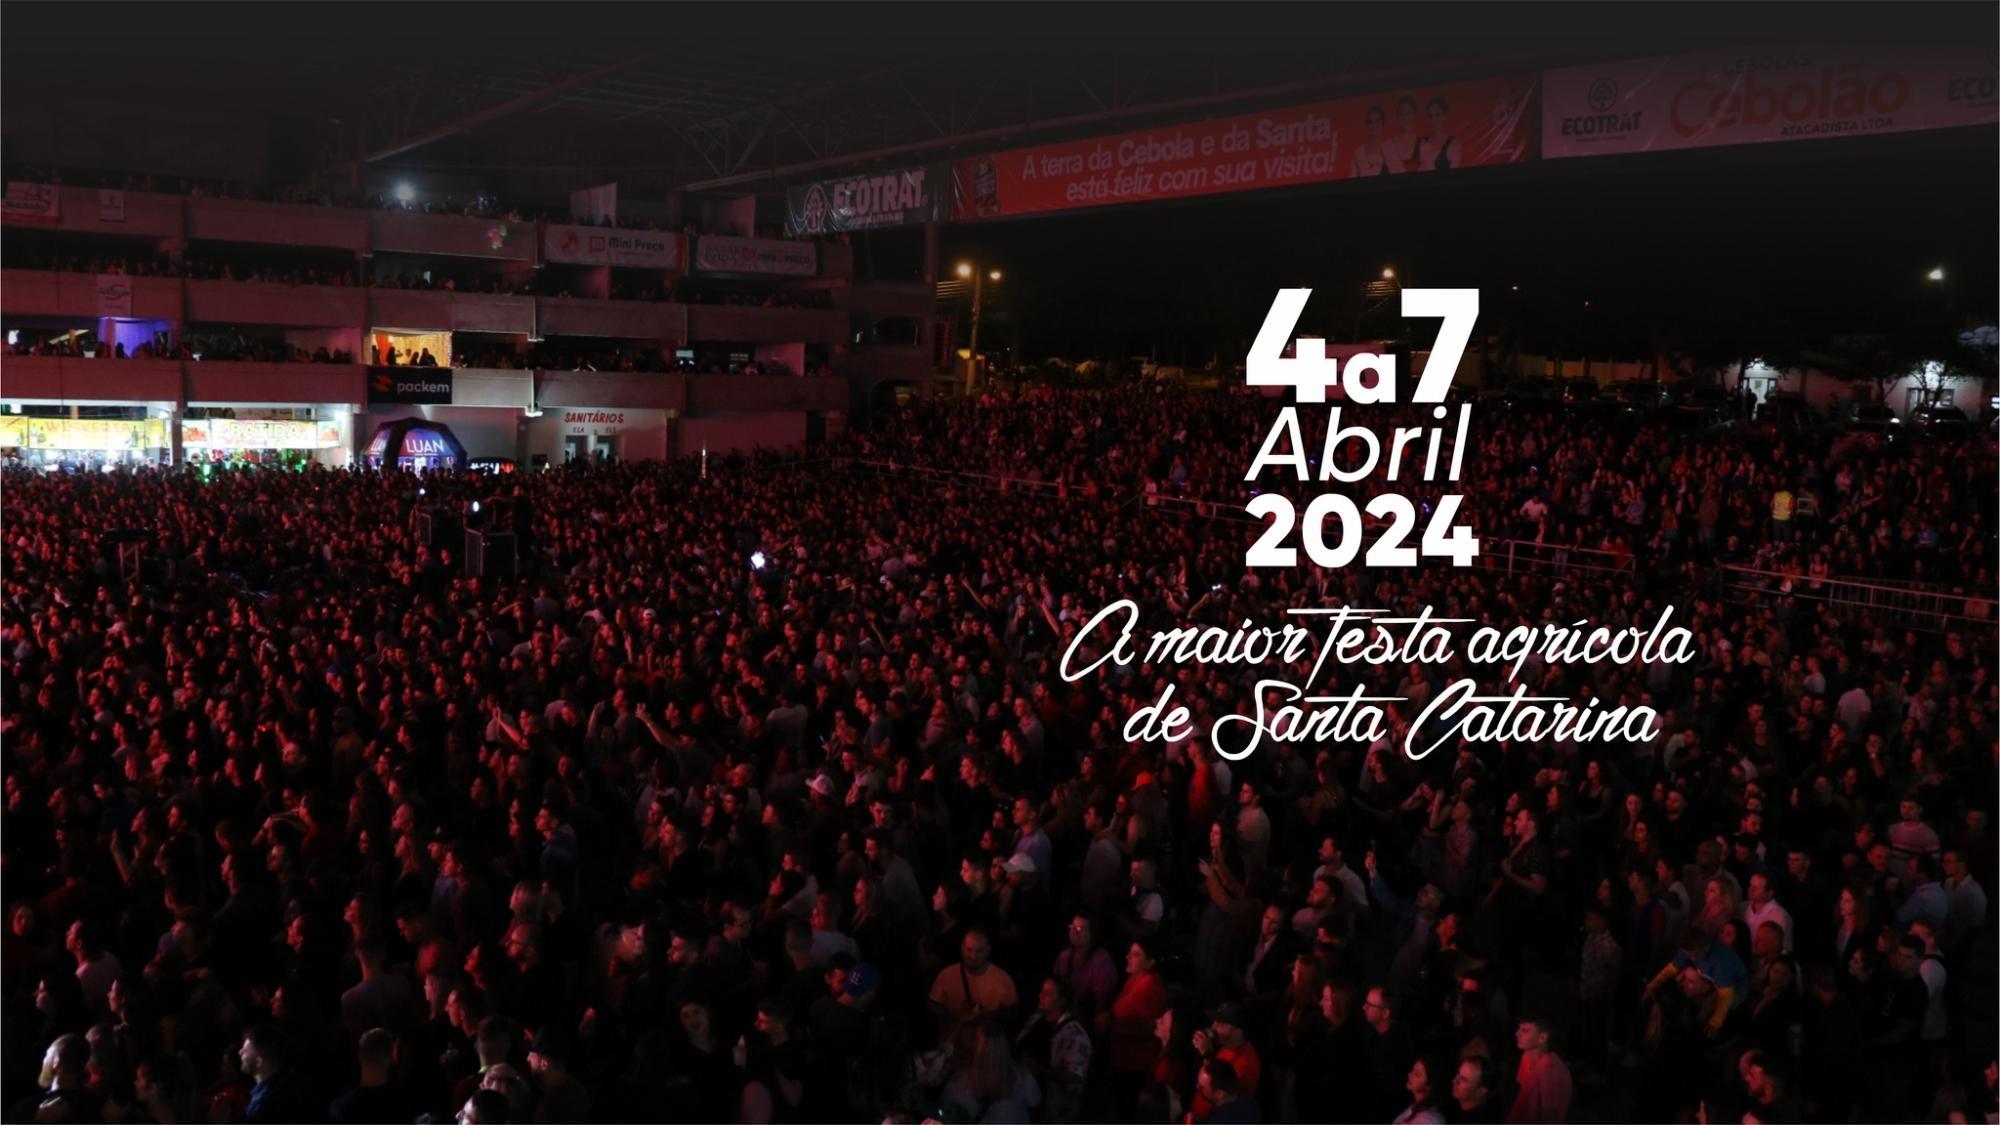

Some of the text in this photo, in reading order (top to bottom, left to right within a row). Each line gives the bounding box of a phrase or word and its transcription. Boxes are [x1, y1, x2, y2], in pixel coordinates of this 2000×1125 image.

[1670, 61, 1911, 137] Cebolão
[1561, 112, 1643, 136] ECOTRAT
[1780, 122, 1859, 136] ATACADISTA
[1021, 114, 1331, 180] A terra da Cebola e da Santa
[1066, 130, 1338, 201] está feliz com sua visita!
[833, 170, 926, 217] ECOTRAT
[608, 237, 632, 249] Mini
[397, 380, 450, 395] packem
[564, 411, 624, 424] SANITÁRIOS
[406, 440, 445, 453] LUAN
